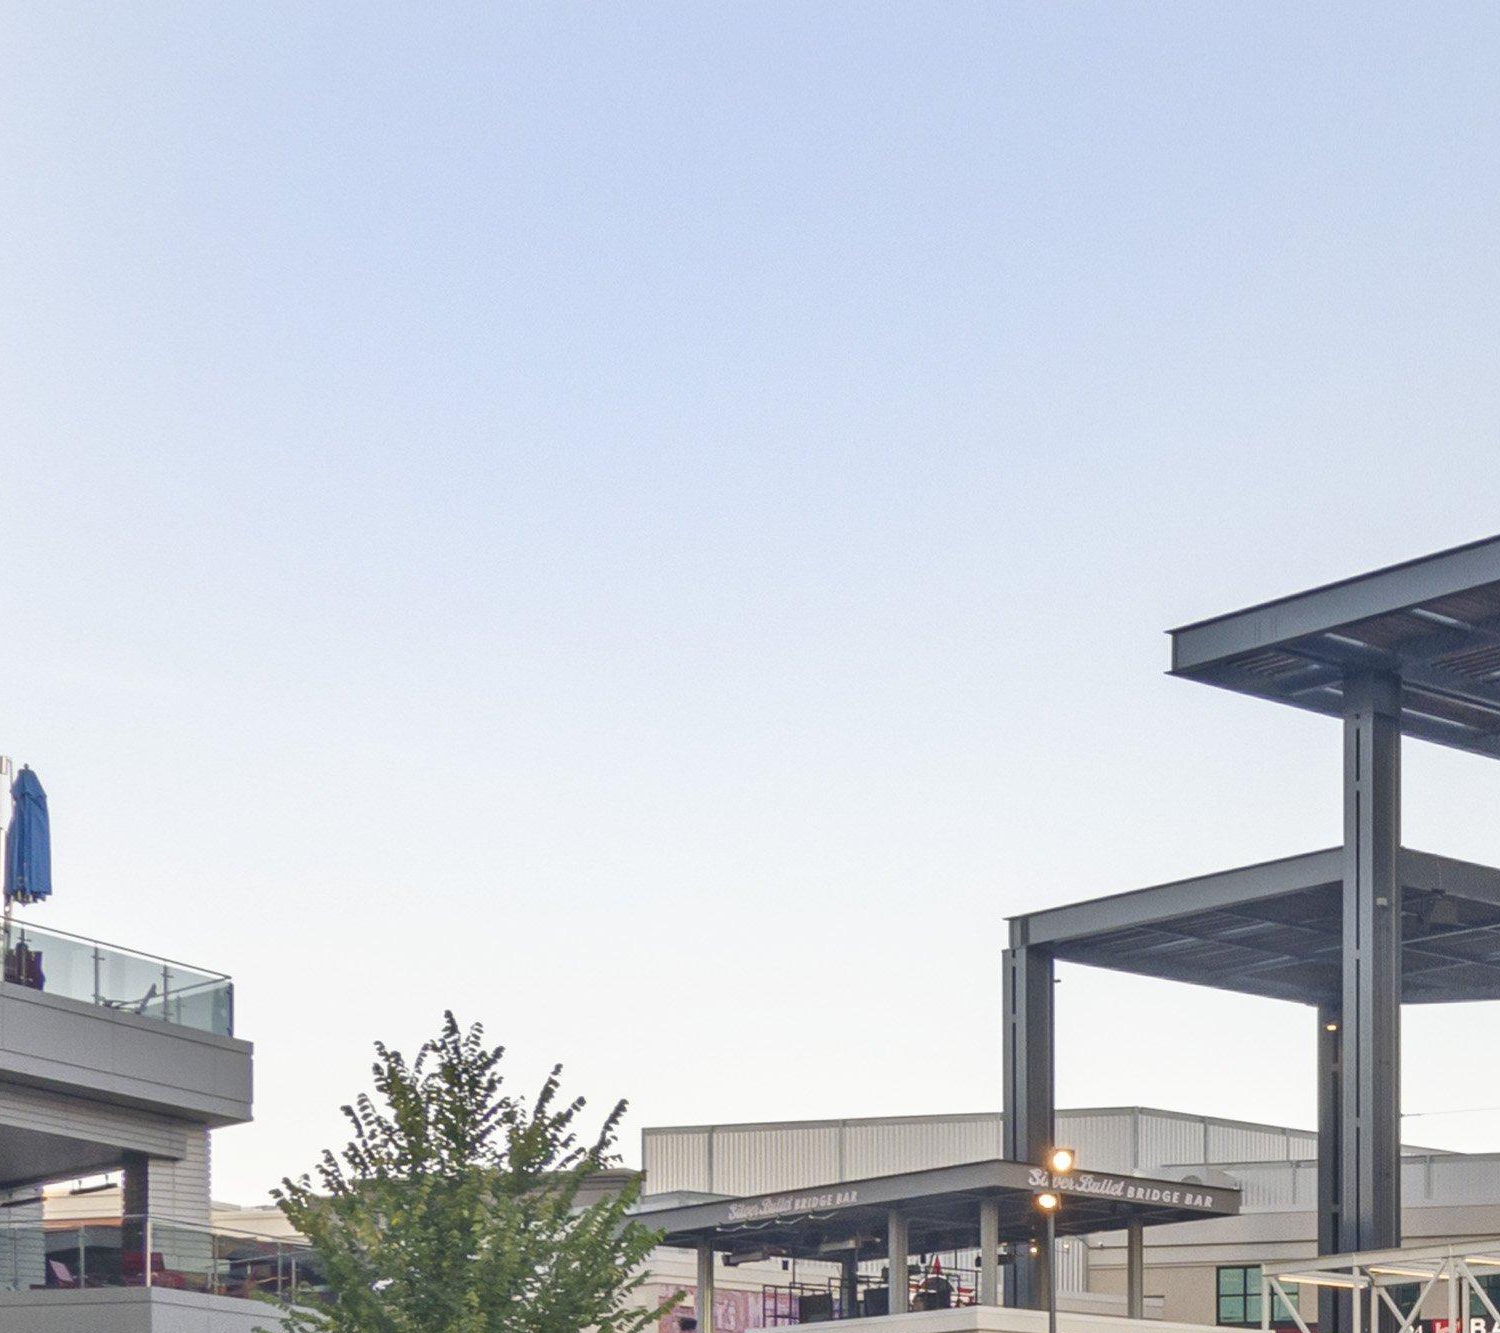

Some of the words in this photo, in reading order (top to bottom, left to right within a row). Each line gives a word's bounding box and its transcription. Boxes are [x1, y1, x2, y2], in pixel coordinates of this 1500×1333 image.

[836, 1190, 858, 1205] BAR
[1028, 1167, 1074, 1190] Siver
[1127, 1185, 1180, 1203] BRIDGE
[1184, 1193, 1213, 1208] BAR
